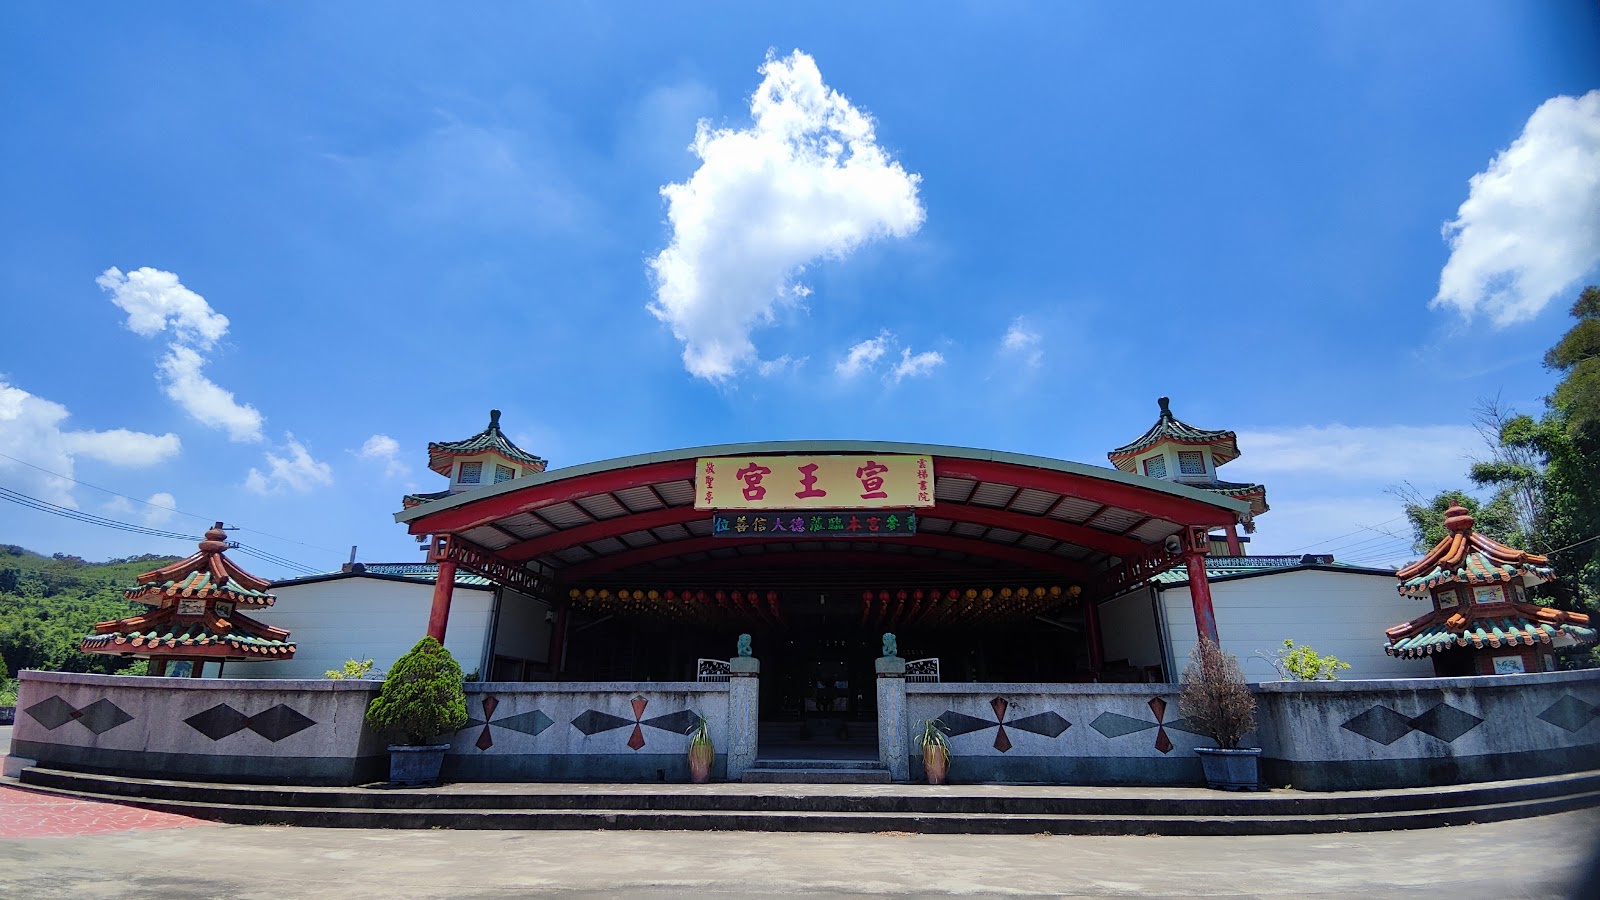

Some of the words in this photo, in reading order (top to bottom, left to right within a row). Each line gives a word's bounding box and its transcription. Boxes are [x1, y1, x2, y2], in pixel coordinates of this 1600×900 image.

[736, 461, 888, 501] 宣王宮
[917, 459, 930, 501] 雲梯書院
